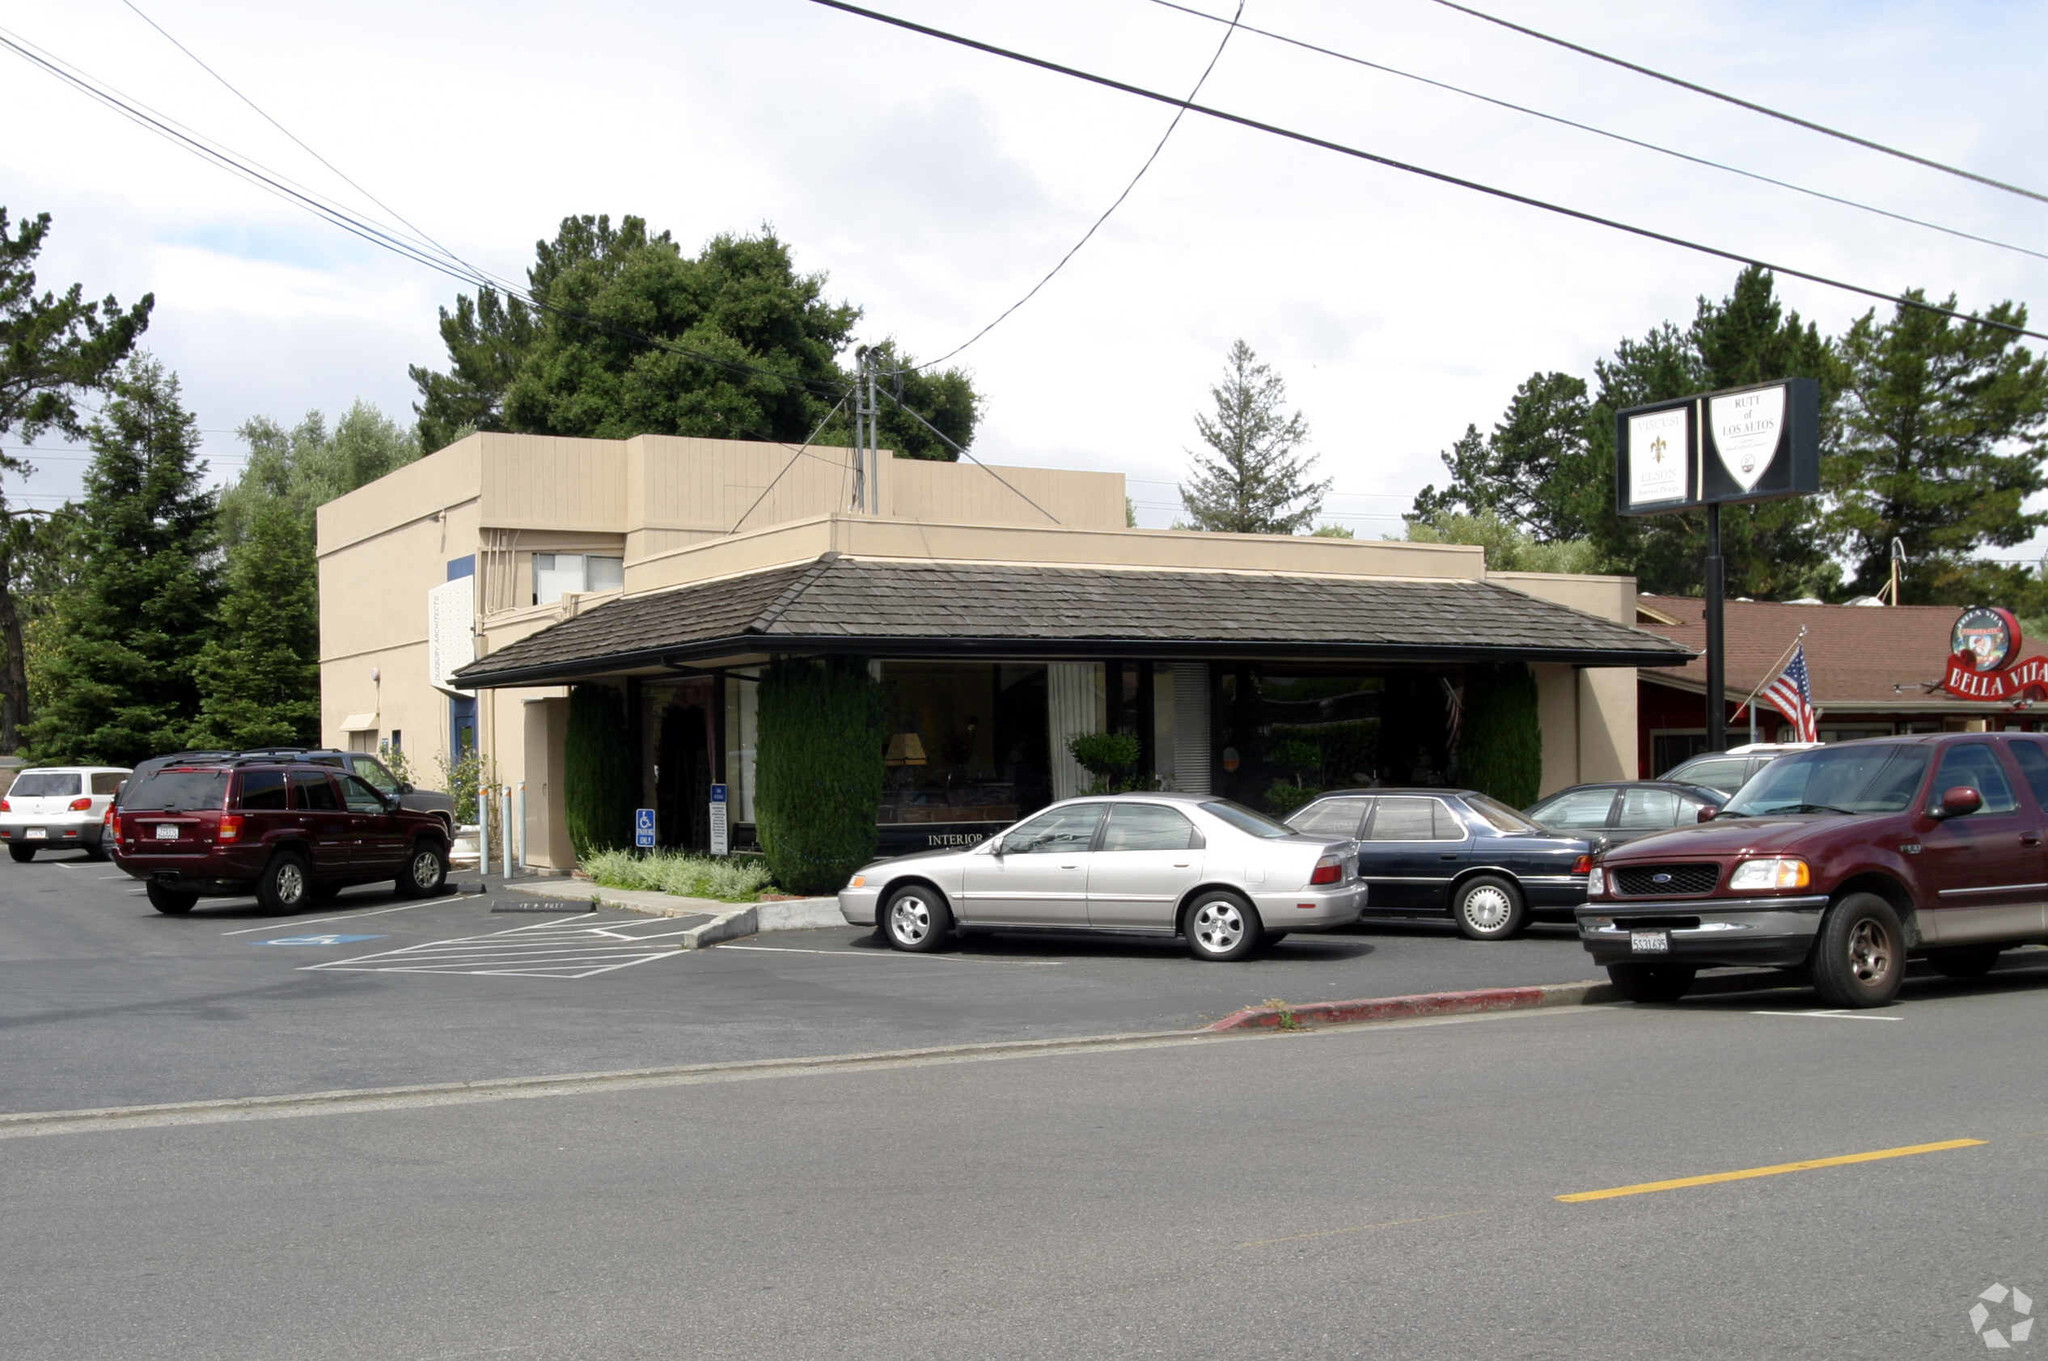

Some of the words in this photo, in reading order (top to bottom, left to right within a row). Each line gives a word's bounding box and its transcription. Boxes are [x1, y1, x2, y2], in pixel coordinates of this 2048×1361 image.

[1734, 393, 1761, 409] RUTT
[1743, 409, 1753, 420] of
[1722, 423, 1742, 437] LOS
[1743, 417, 1775, 433] ALTOS
[1949, 667, 2004, 697] BELLA
[2009, 661, 2048, 687] VITA
